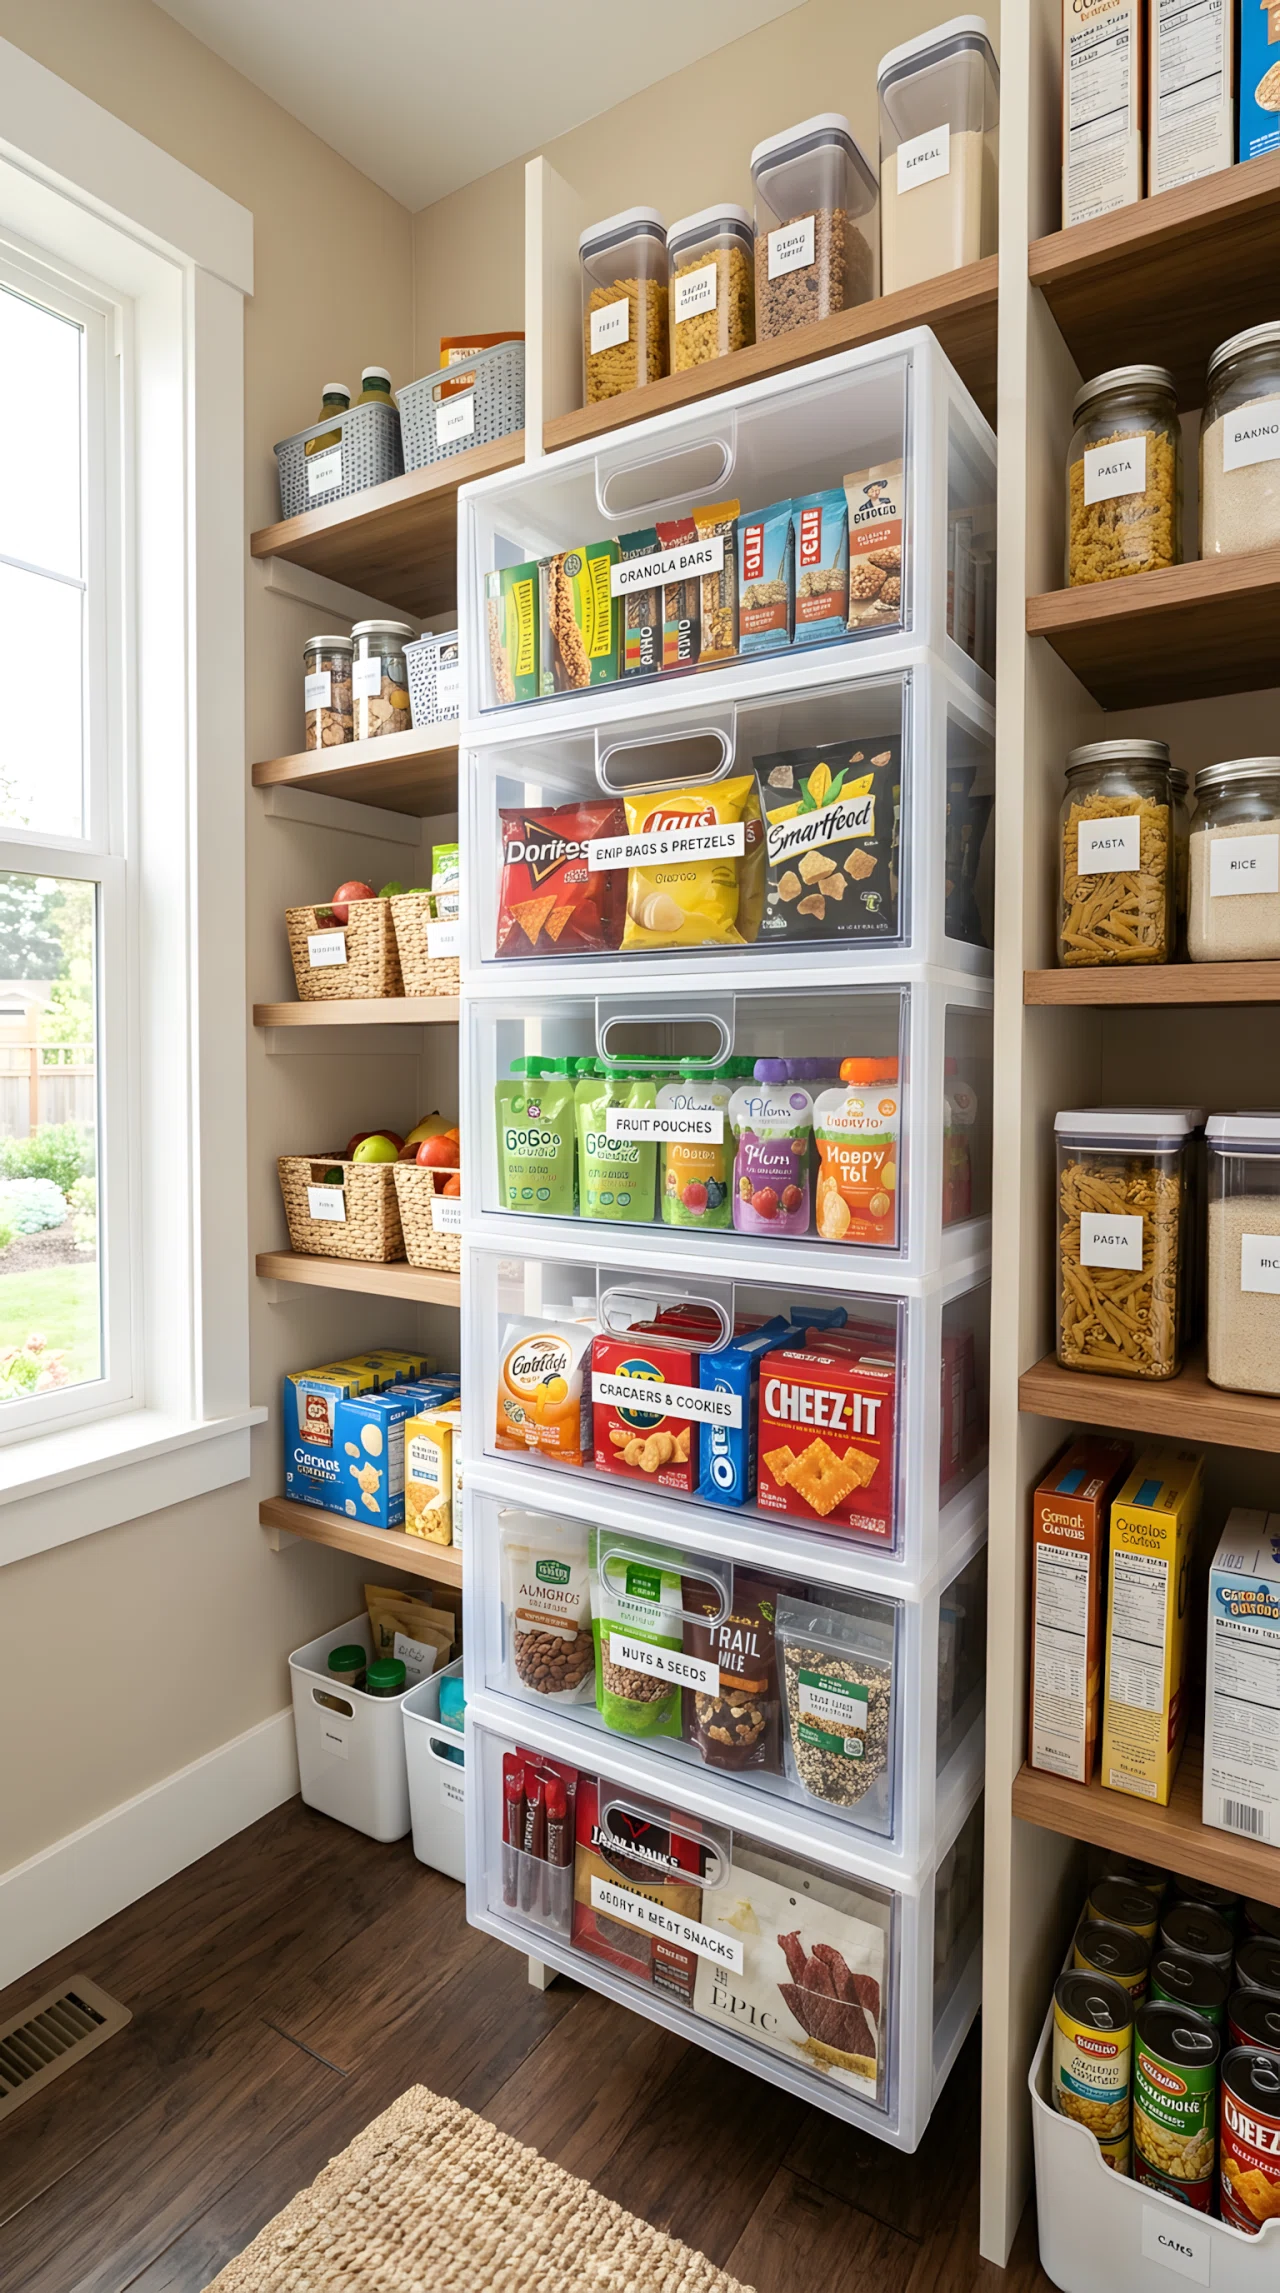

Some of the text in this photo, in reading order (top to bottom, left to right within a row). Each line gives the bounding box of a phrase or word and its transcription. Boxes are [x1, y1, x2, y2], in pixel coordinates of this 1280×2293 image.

[679, 550, 713, 570] BARS
[672, 833, 735, 853] PRETZELS
[616, 1118, 712, 1134] FRUIT POUCHES
[676, 1396, 732, 1416] COOKIES
[709, 1625, 761, 1658] TRAIL
[667, 1660, 707, 1683] SEEDS
[710, 1985, 778, 2034] EPIC
